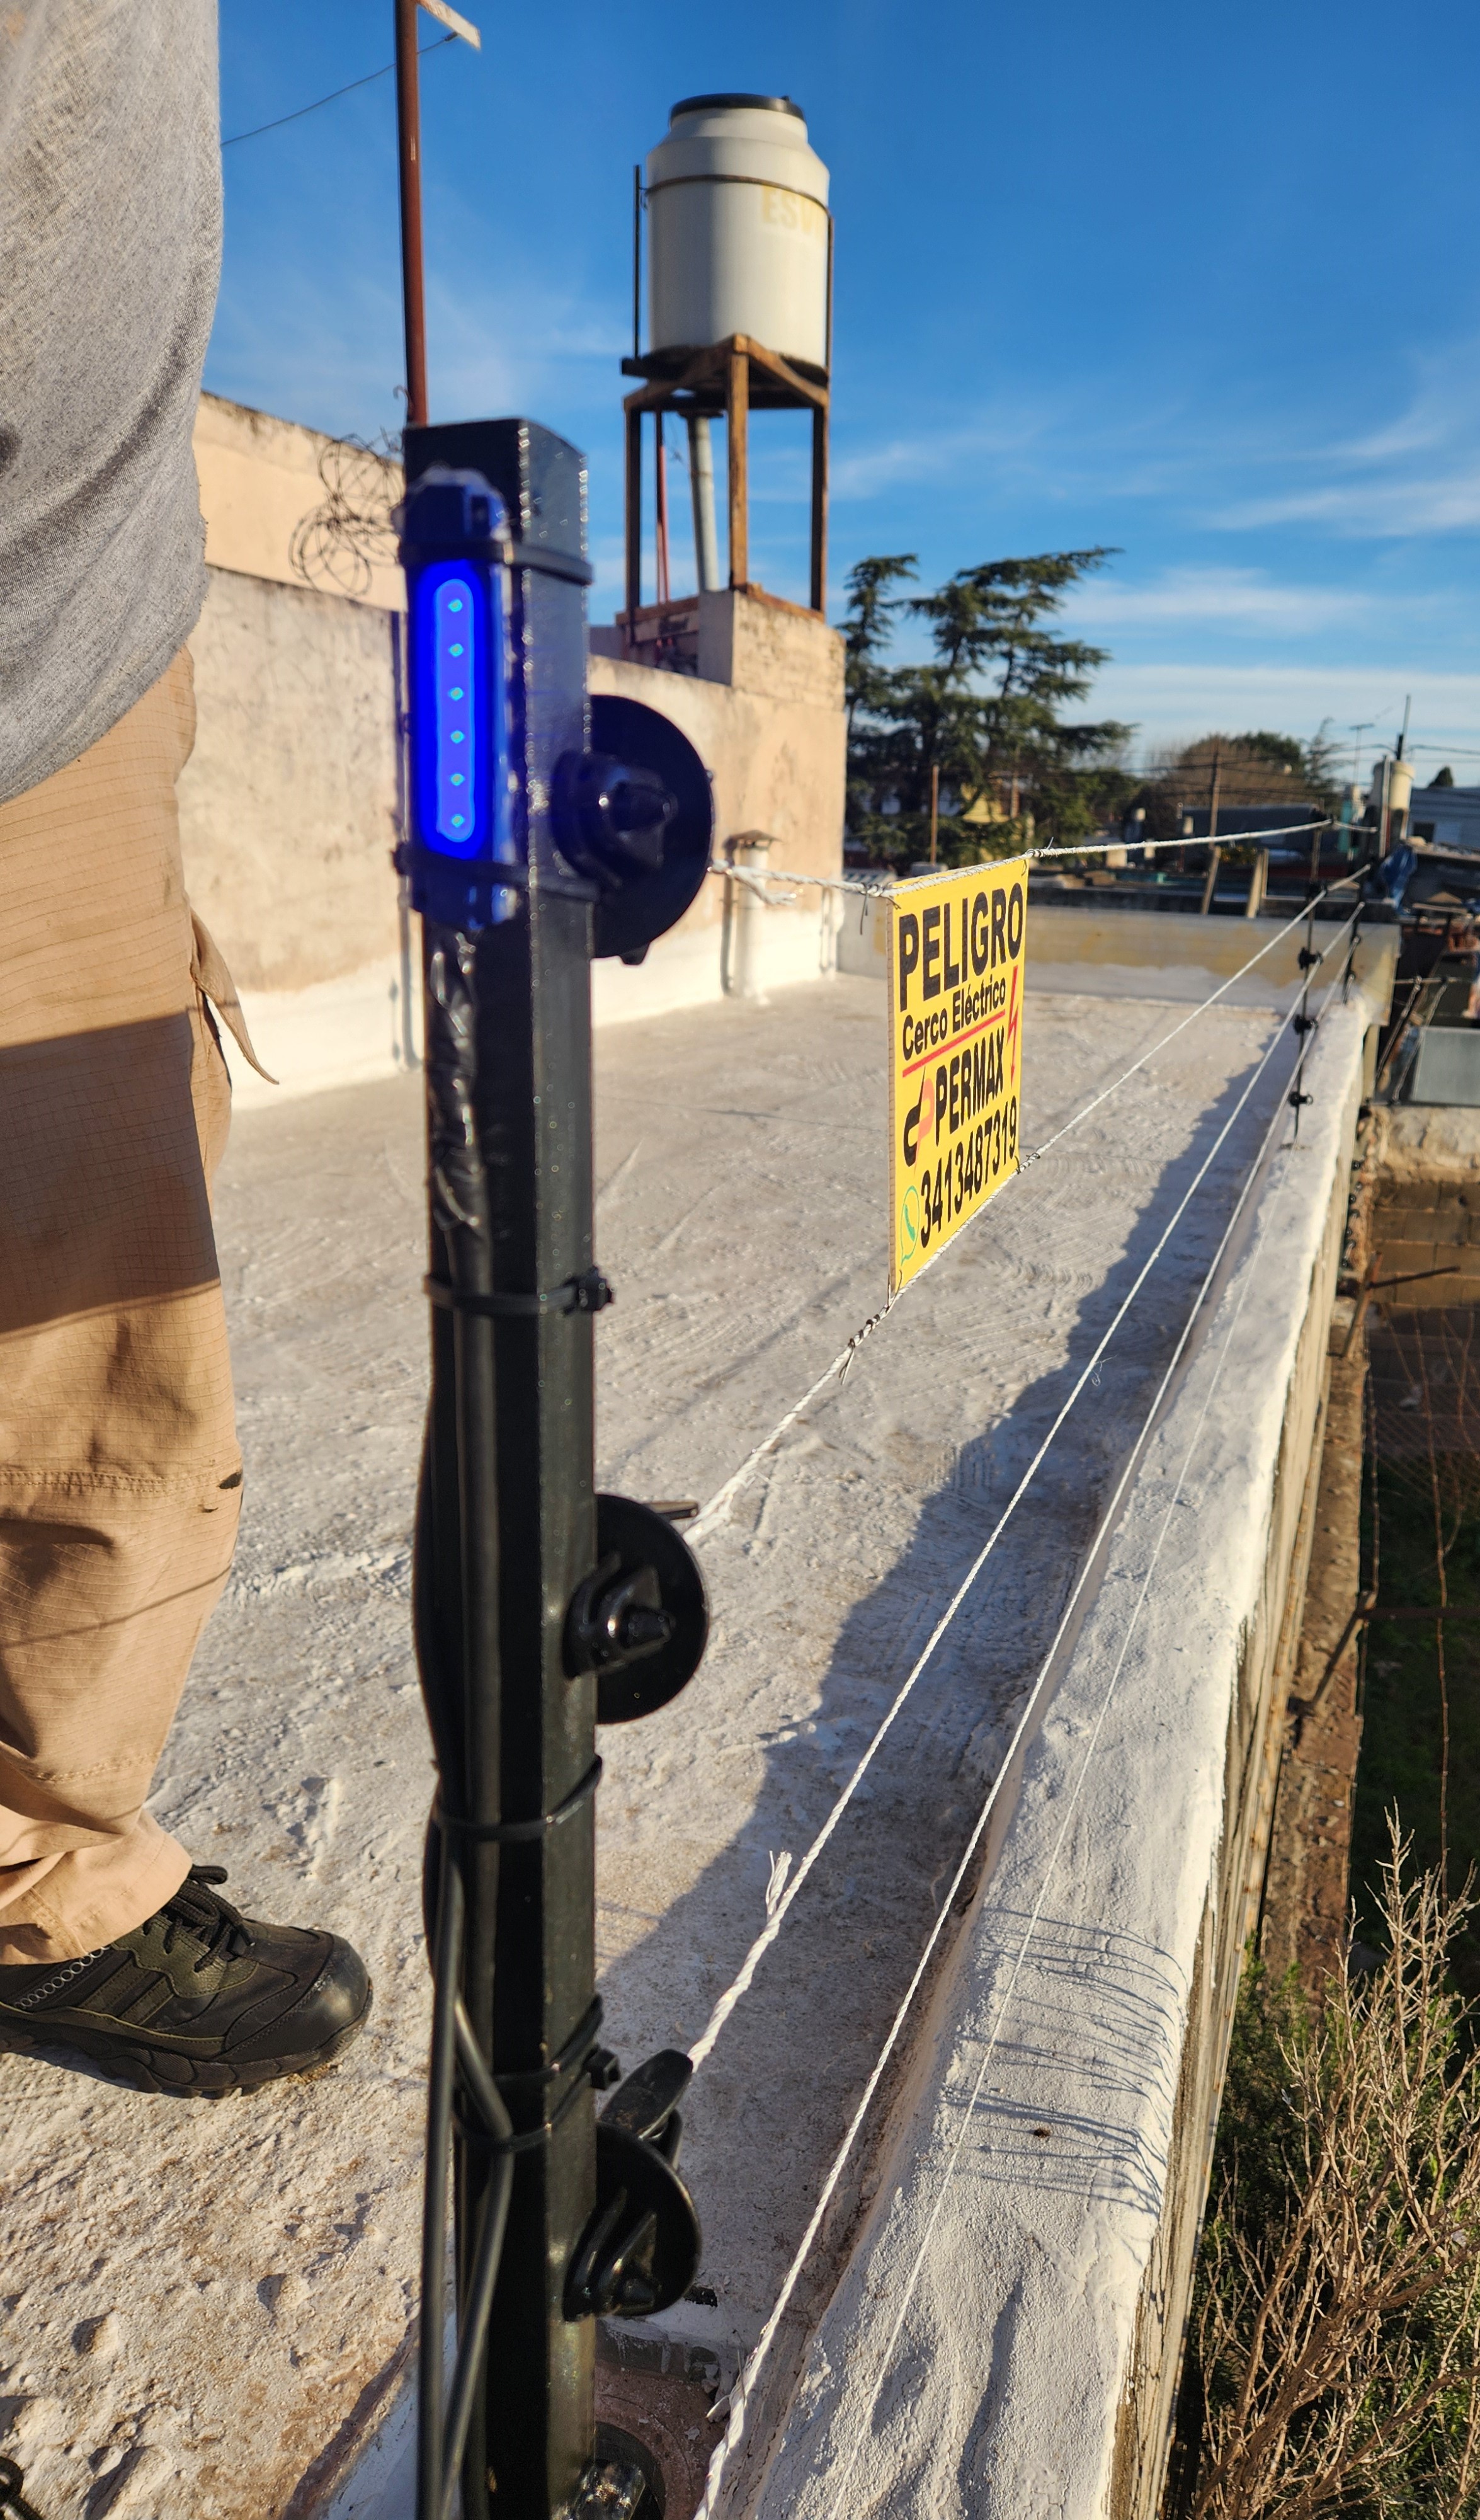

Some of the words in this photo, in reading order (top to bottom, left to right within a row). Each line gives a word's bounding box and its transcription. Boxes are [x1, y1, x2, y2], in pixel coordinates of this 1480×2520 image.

[899, 882, 1023, 1012] PELIGRO
[902, 1007, 948, 1062] Cerco
[952, 974, 1006, 1034] Eléctrico
[935, 1024, 1005, 1147] PERMAX
[920, 1095, 1017, 1249] 3413487319
